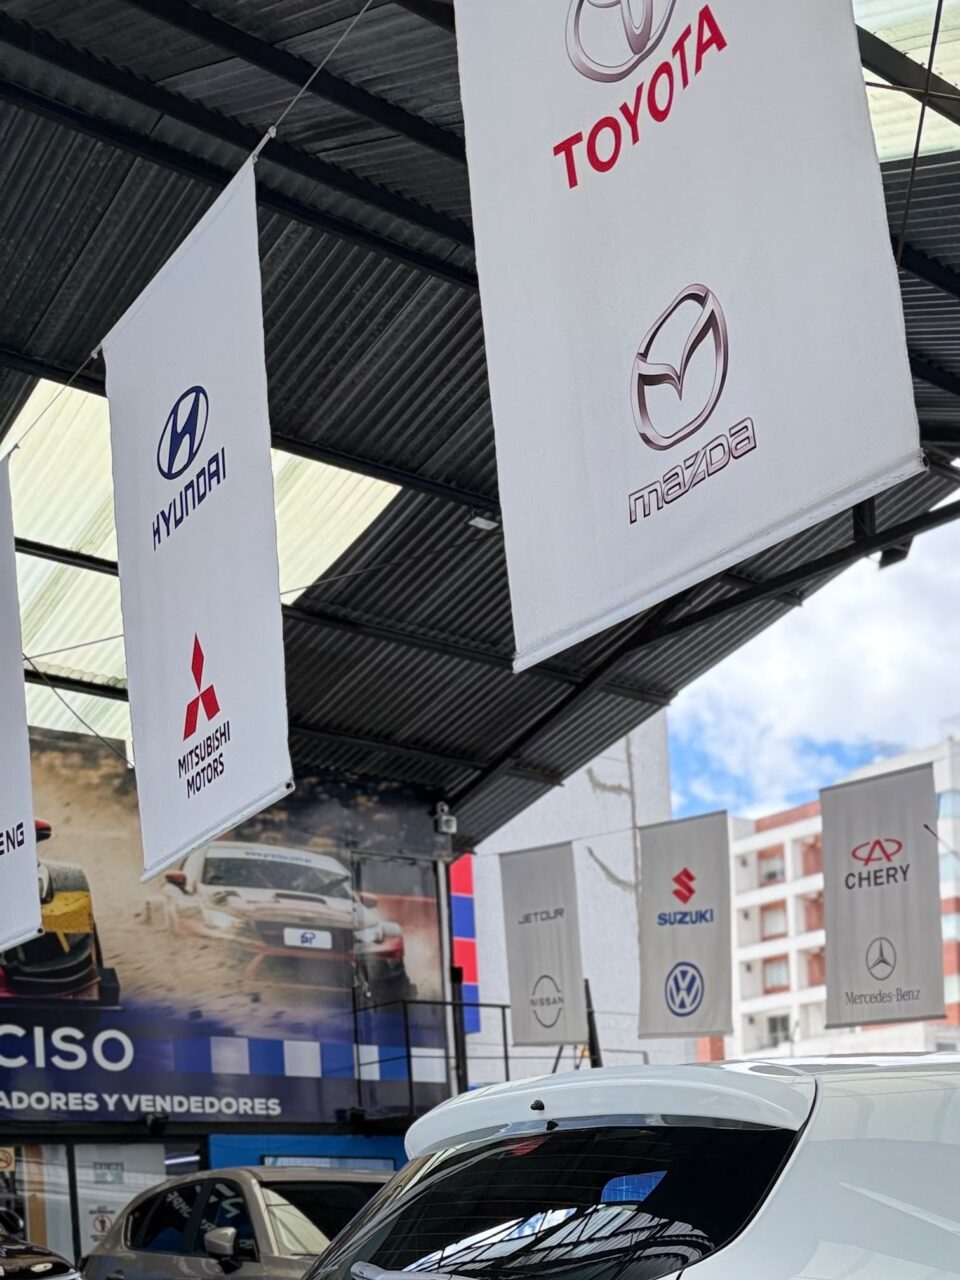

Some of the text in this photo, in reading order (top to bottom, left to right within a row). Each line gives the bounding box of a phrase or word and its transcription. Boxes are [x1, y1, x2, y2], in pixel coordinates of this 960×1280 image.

[553, 5, 728, 189] TOYOTA
[153, 447, 227, 551] HYUNDAI
[178, 720, 231, 779] MITSUBISHI
[187, 752, 225, 799] MOTORS
[845, 864, 911, 890] CHERY
[518, 908, 565, 925] JETOUR
[657, 908, 714, 926] SUZUKI
[530, 996, 564, 1007] NISSAN
[845, 988, 921, 1005] Mercedes-Benz
[0, 1024, 134, 1072] CISO
[102, 1093, 119, 1111] Y
[122, 1094, 282, 1116] VENDEDORES
